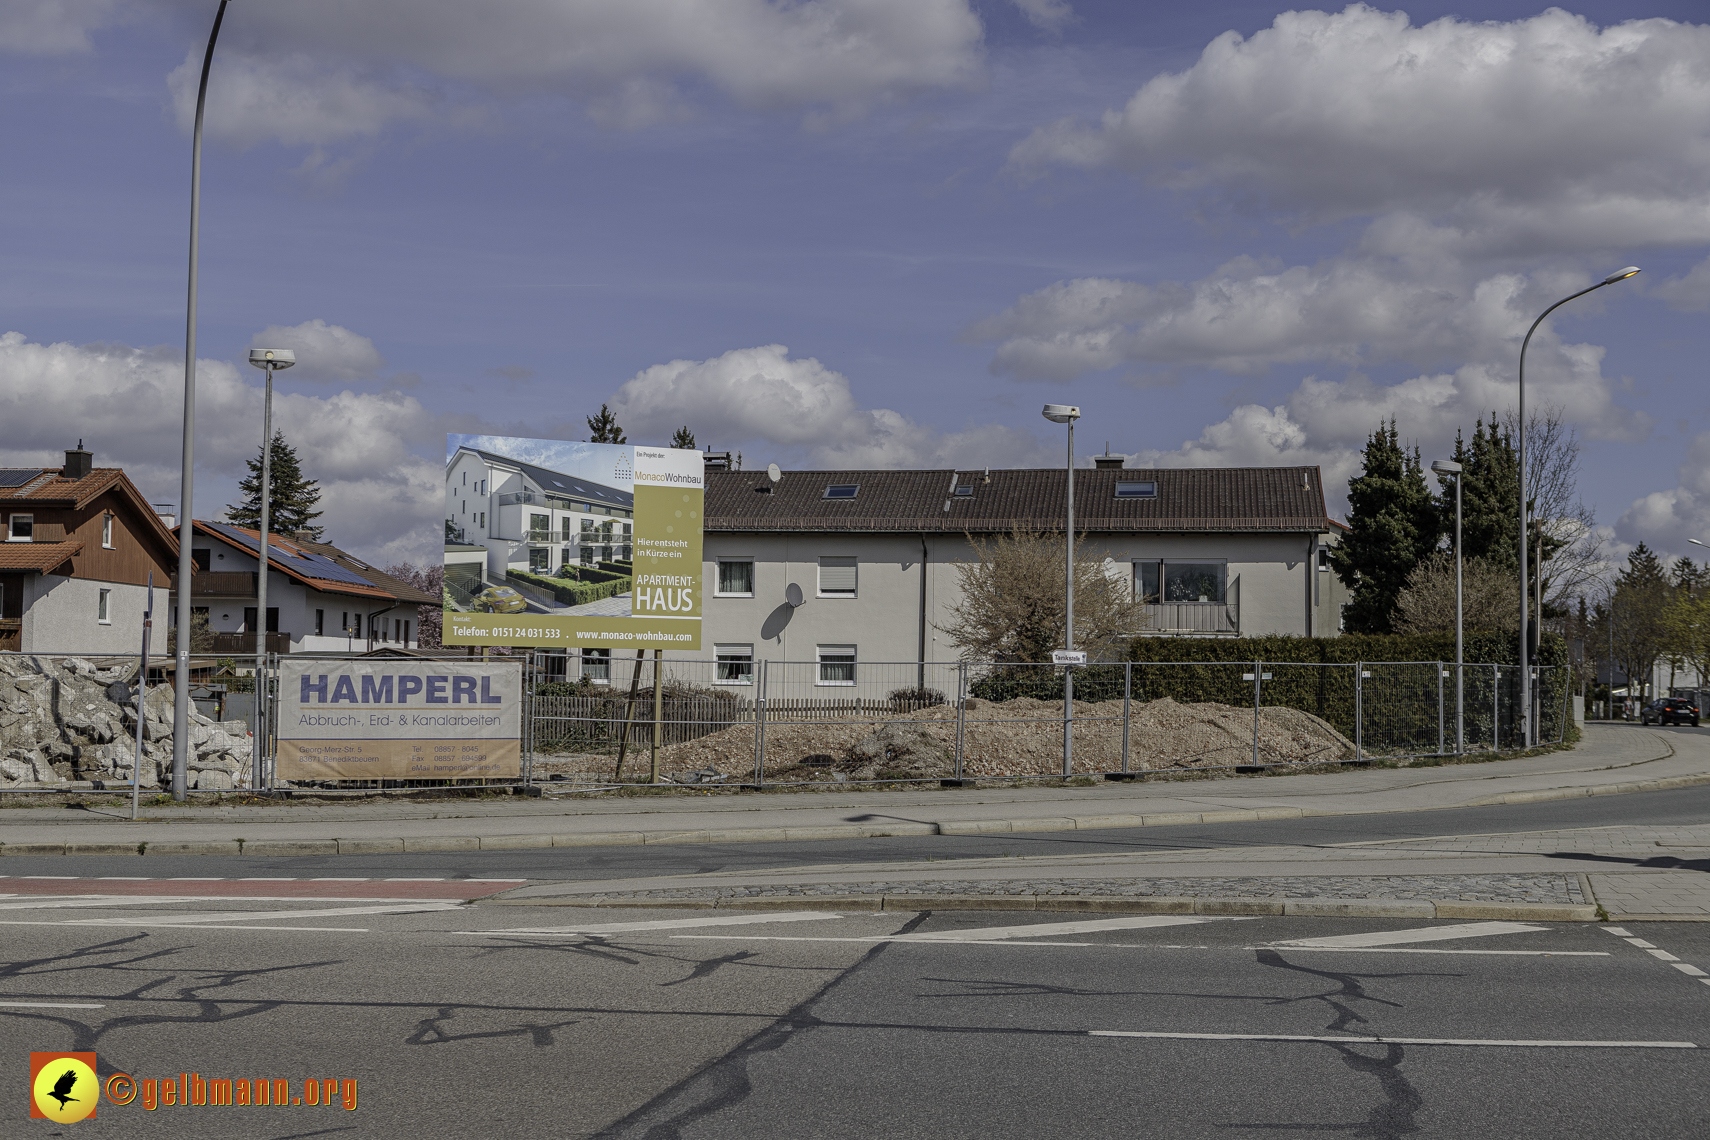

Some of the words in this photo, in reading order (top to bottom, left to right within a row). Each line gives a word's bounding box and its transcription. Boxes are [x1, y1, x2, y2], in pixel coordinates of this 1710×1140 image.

[643, 451, 657, 459] Projekt
[634, 471, 702, 484] MonacoWohnbau
[637, 538, 654, 546] Hier
[654, 540, 688, 548] entsteht
[646, 549, 668, 557] Kürze
[669, 550, 682, 558] ein
[636, 575, 696, 587] APARTMENT-
[636, 587, 693, 612] HAUS
[453, 626, 489, 637] Telefon:
[492, 627, 513, 638] 0151
[515, 628, 526, 638] 24
[527, 628, 543, 638] 031
[545, 628, 561, 639] 533
[576, 631, 692, 641] www.monaco-wohnbau.com
[300, 674, 502, 704] HAMPERL
[299, 714, 365, 727] Abbruch-,
[369, 714, 395, 726] Erd-
[398, 714, 409, 726] &
[412, 714, 501, 726] Kanalarbeiten
[299, 746, 355, 754] Georg-Merz-Str.
[411, 745, 424, 753] Tel.
[433, 745, 456, 753] 08857
[461, 745, 479, 753] 8045
[298, 755, 320, 763] 83671
[323, 755, 380, 763] Benediktbeuern
[411, 764, 431, 772] eMail
[433, 763, 501, 773] hamperl@online.de
